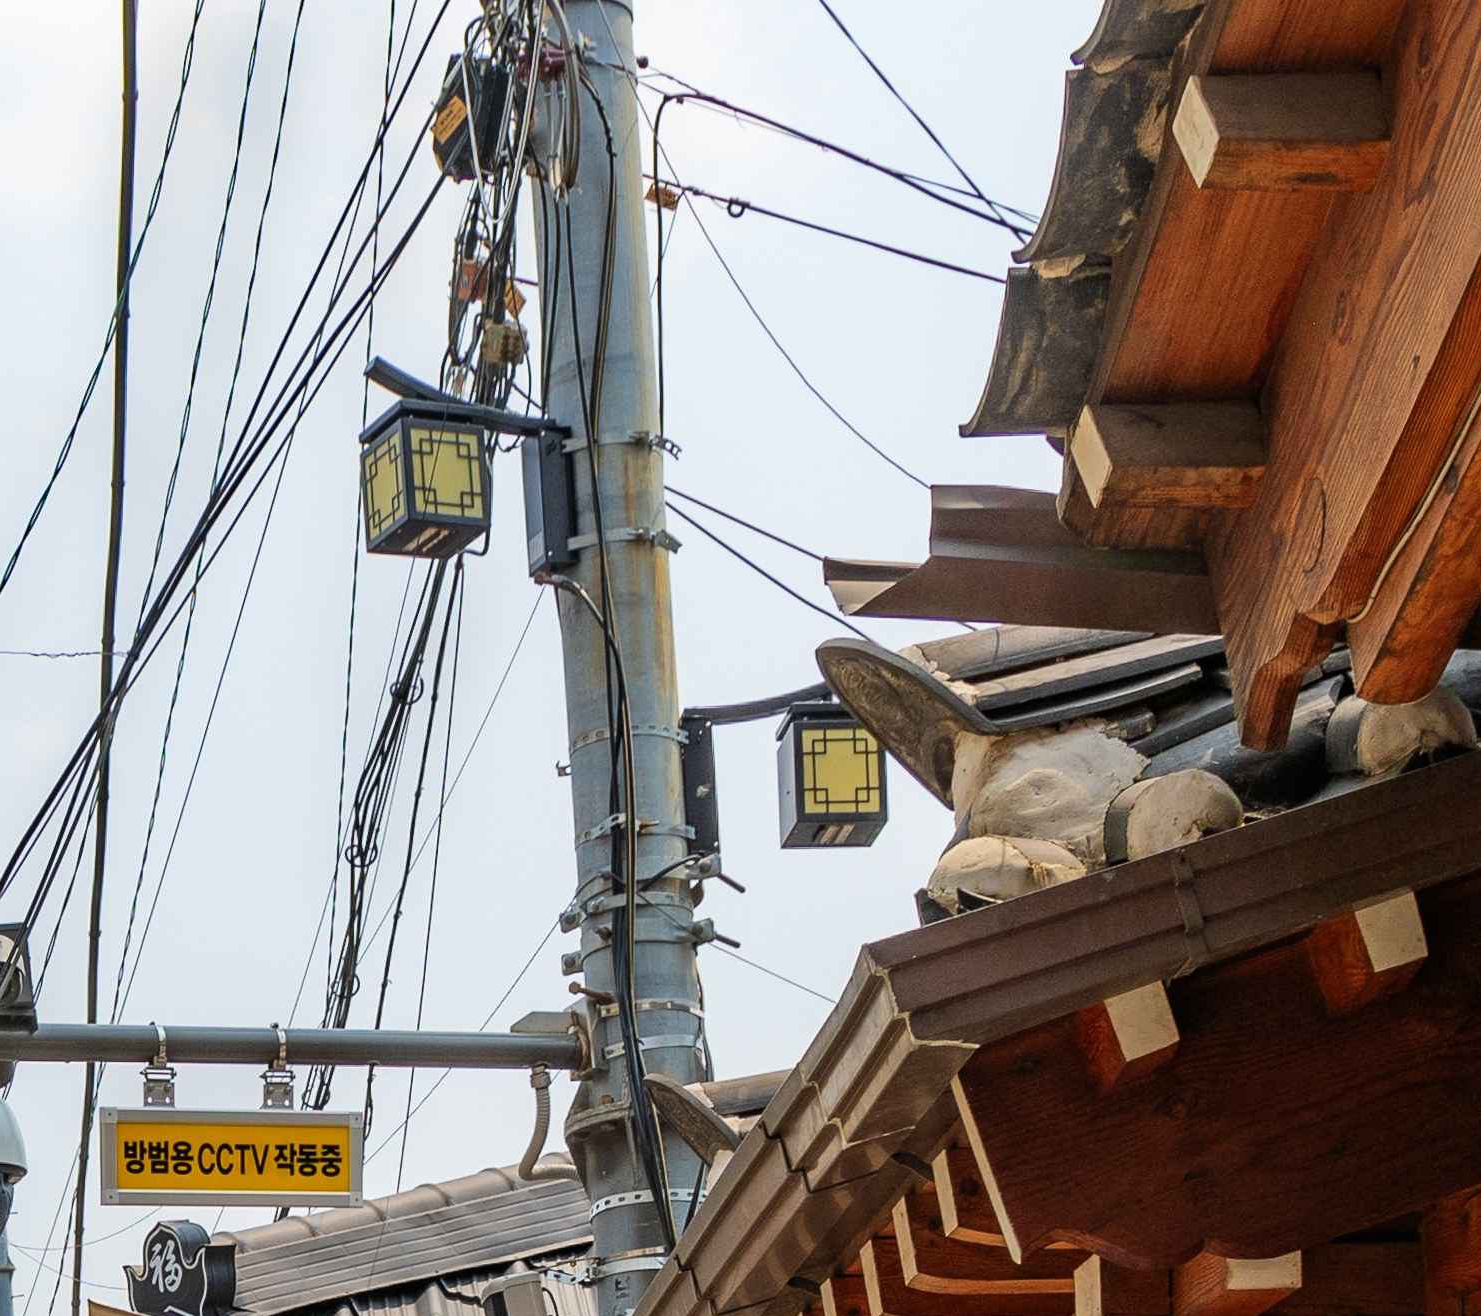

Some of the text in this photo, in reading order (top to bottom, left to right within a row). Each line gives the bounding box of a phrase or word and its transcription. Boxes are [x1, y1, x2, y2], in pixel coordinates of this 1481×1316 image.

[124, 1141, 342, 1177] 방범용 CCTV 작동중
[150, 1239, 183, 1293] 福
